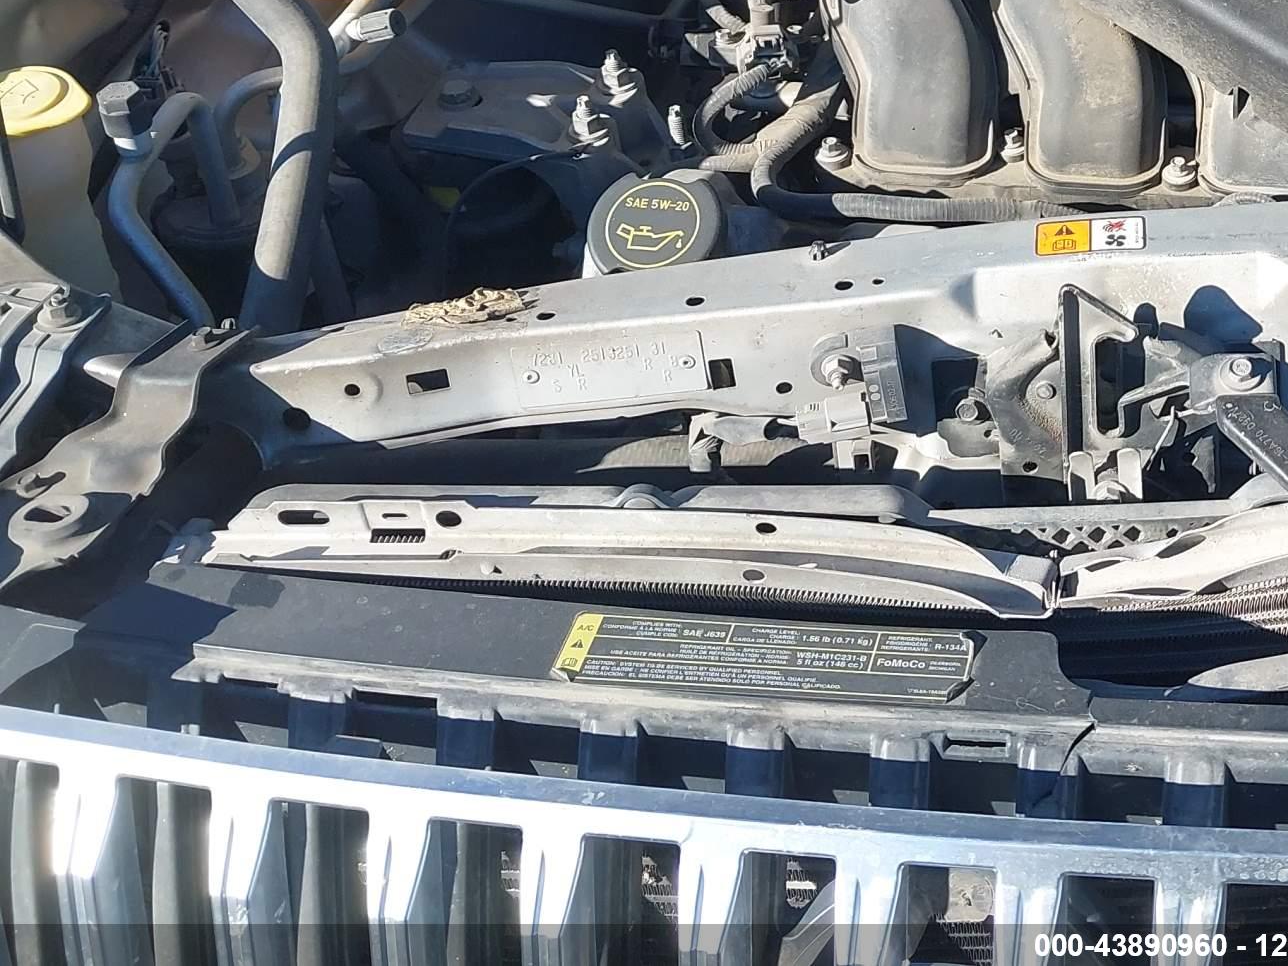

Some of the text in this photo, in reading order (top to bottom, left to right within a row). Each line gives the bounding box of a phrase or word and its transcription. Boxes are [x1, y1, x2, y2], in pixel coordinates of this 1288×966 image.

[625, 197, 690, 212] SAE 5W-20
[683, 629, 703, 637] SAE
[823, 635, 830, 643] lb
[832, 636, 855, 645] (0.71
[857, 637, 873, 647] kg)
[934, 643, 967, 652] R-134A
[796, 651, 867, 662] WSH-M1C231-B
[877, 658, 925, 669] FoMoCo
